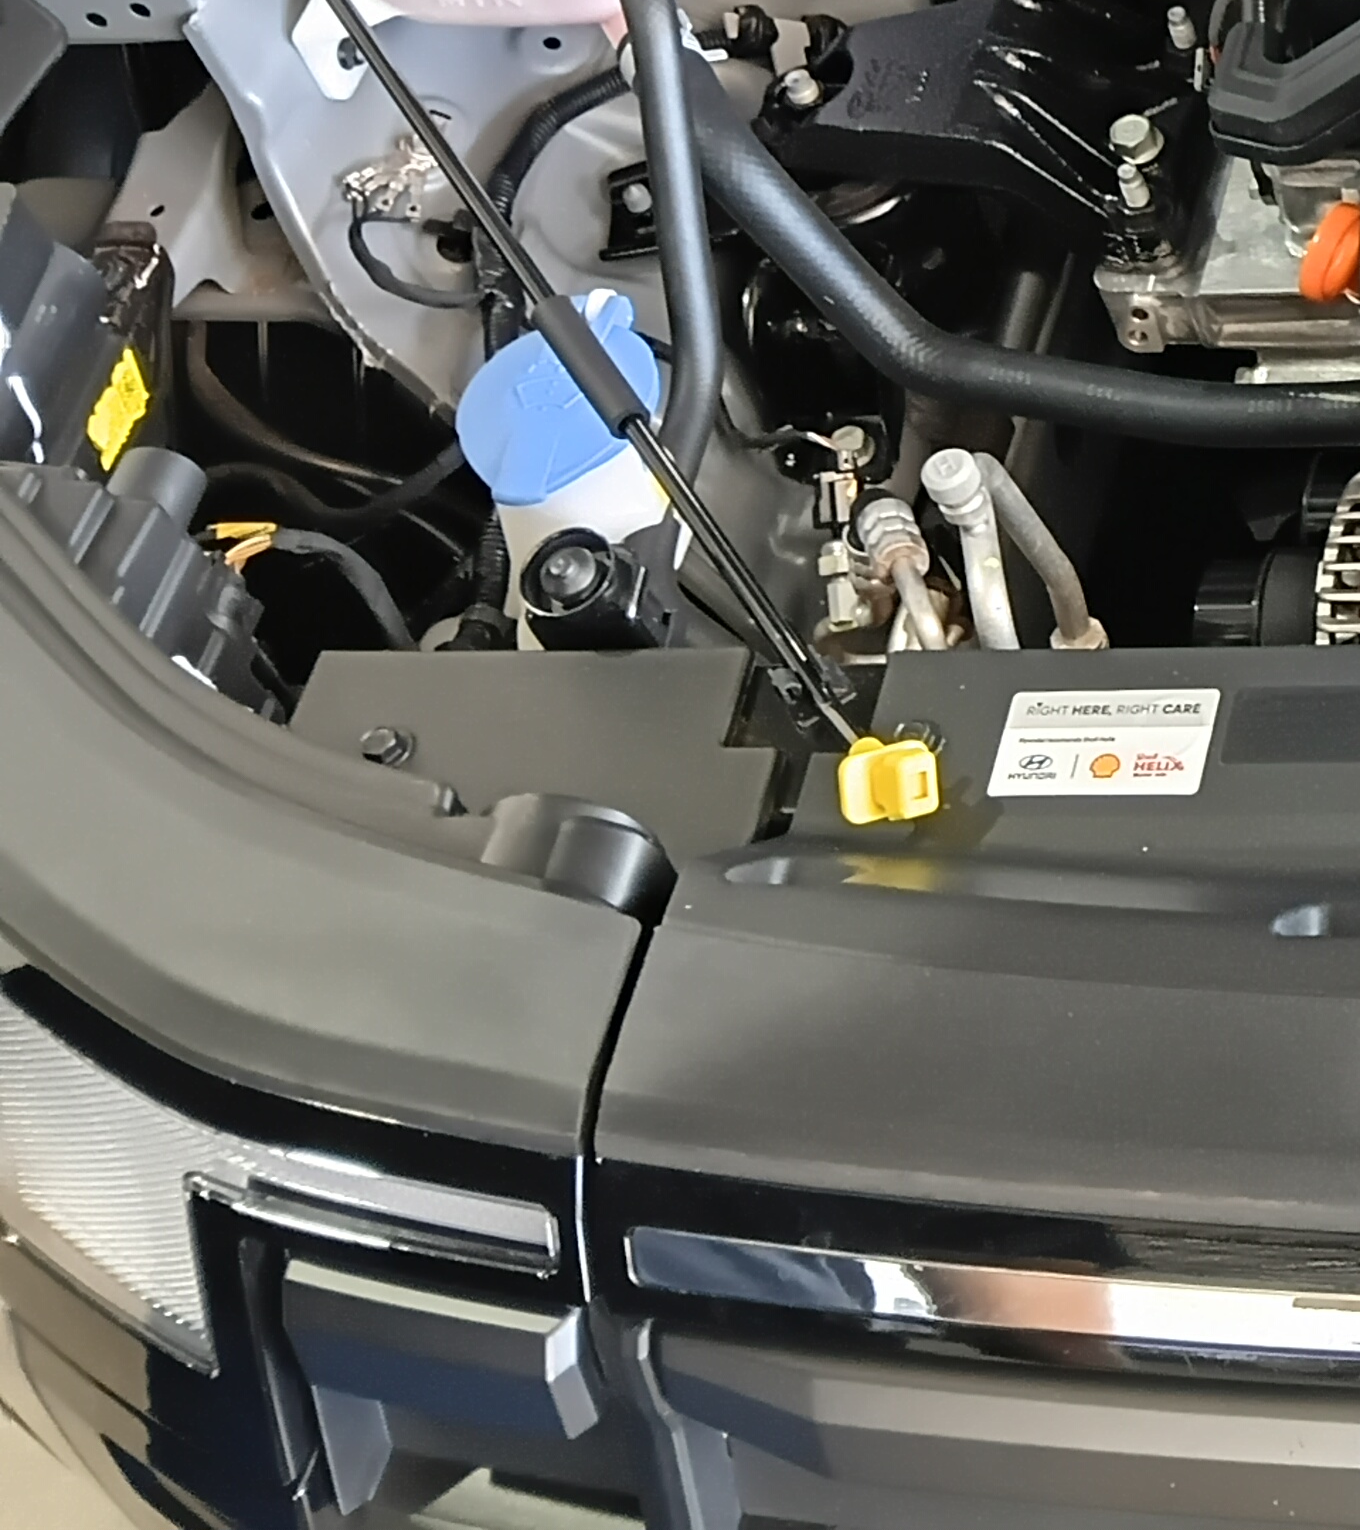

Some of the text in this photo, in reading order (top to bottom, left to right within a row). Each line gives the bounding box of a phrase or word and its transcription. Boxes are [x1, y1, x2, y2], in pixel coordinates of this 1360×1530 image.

[1026, 703, 1202, 717] RIGHT HERE, RIGHT CARE
[1133, 760, 1185, 772] HELIX
[1006, 772, 1058, 780] HYUNDAI
